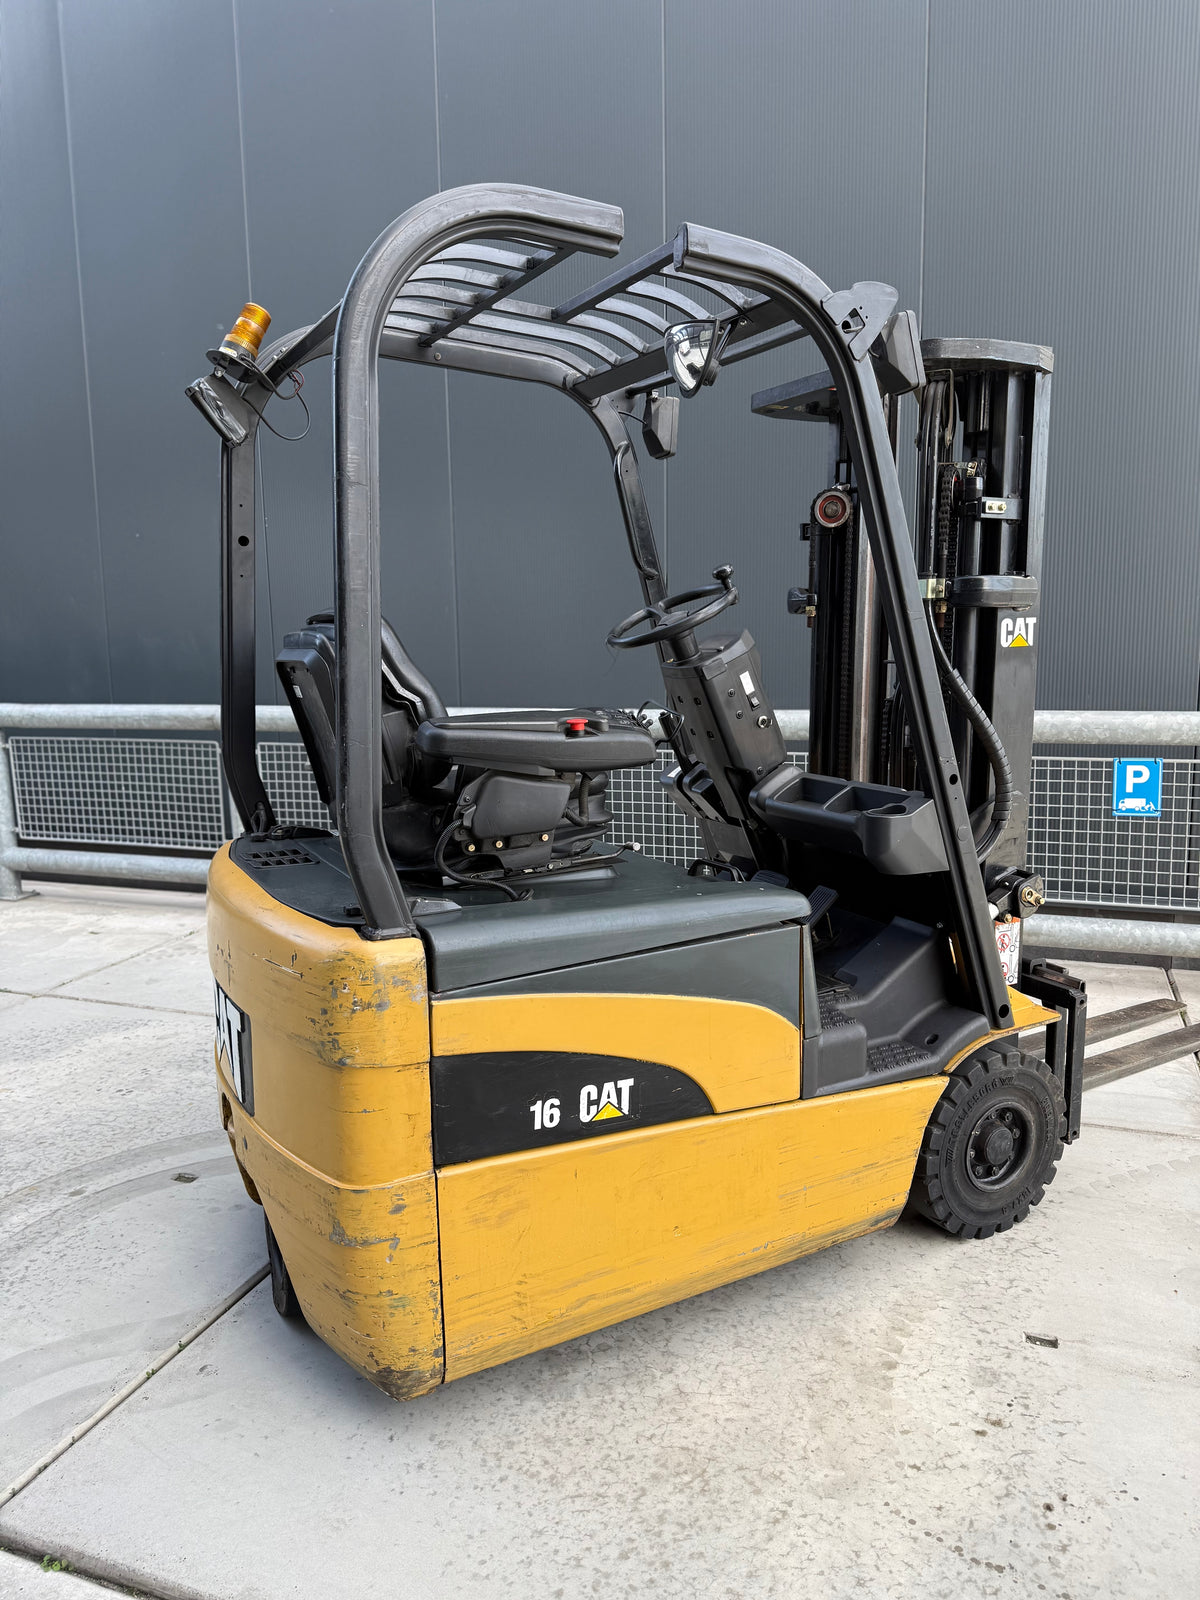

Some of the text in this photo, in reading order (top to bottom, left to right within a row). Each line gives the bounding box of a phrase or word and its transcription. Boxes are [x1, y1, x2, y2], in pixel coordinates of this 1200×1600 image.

[1000, 617, 1037, 648] CAT
[1125, 765, 1150, 793] P
[529, 1078, 635, 1131] 16 CAT
